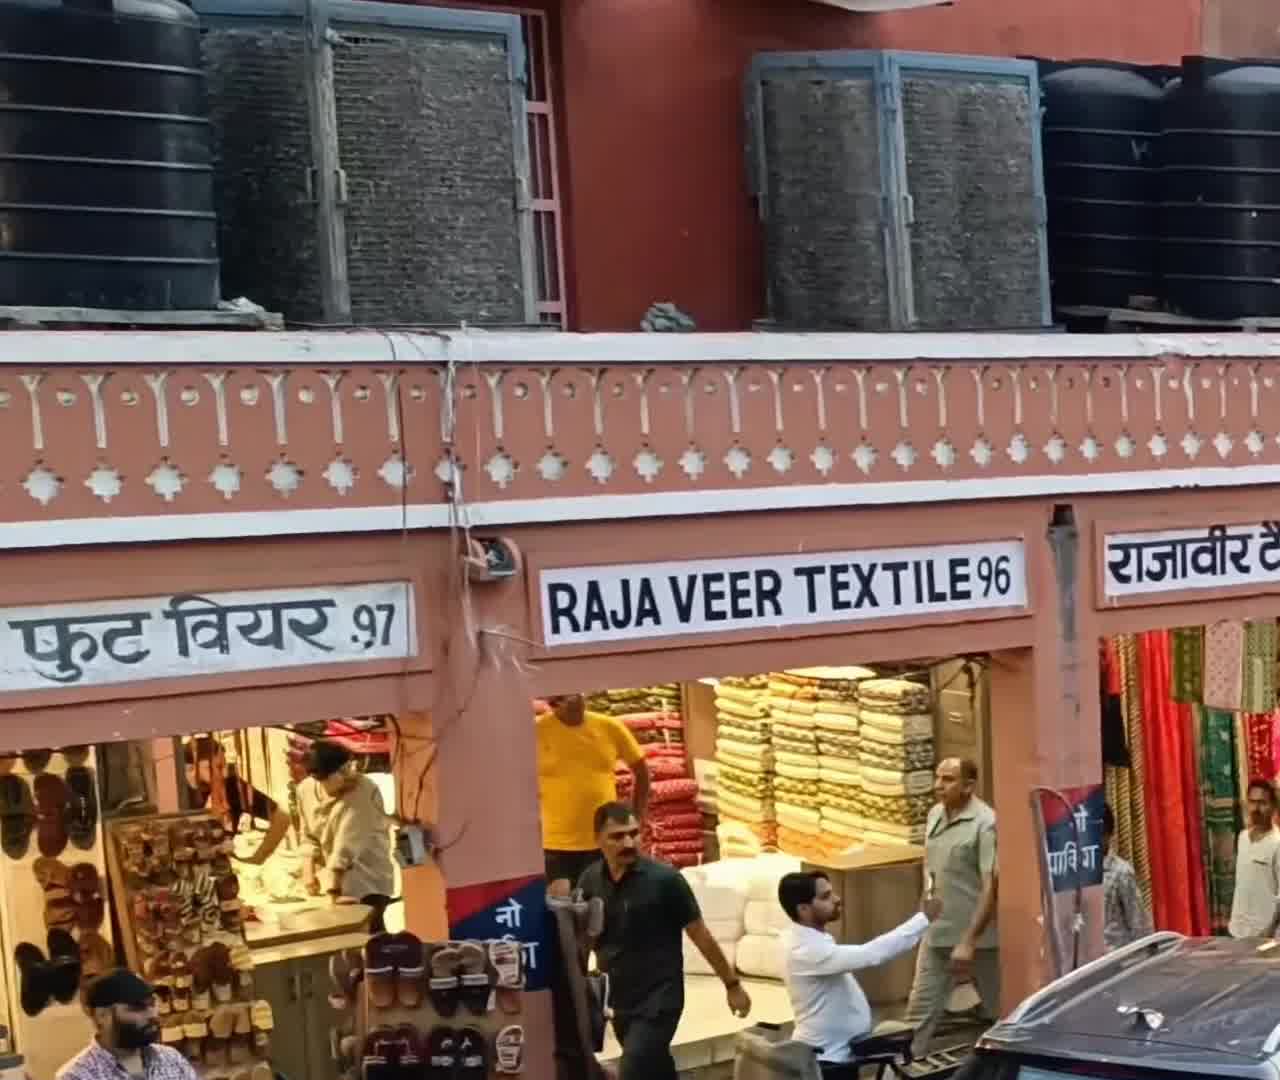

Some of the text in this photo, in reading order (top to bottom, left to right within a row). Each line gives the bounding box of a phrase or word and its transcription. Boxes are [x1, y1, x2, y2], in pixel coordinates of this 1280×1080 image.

[1108, 524, 1253, 584] राजावीर
[547, 555, 1011, 635] RAJA VEER TEXTILE 96
[8, 594, 395, 683] फुट वियर 97
[495, 897, 523, 928] नो
